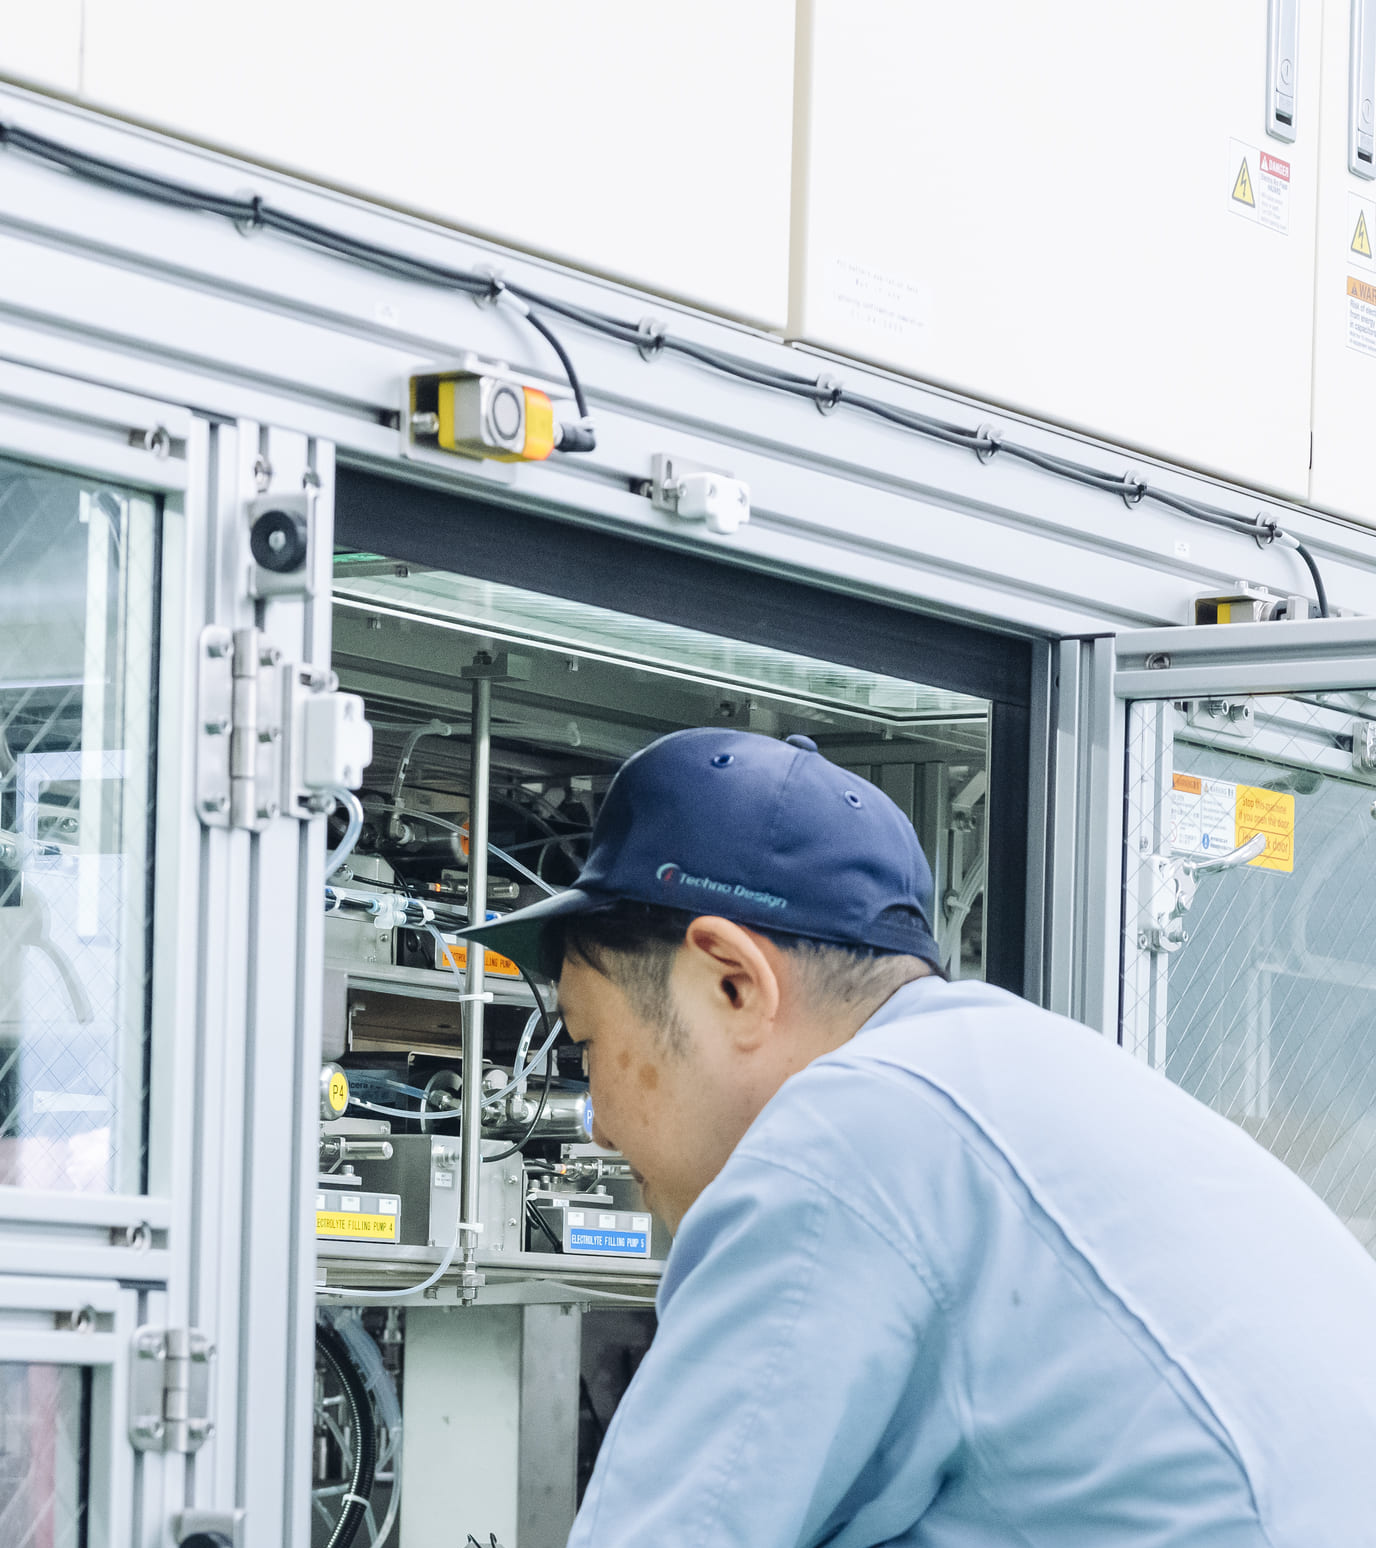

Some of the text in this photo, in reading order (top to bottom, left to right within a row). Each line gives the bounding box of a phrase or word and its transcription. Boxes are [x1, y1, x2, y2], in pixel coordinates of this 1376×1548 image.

[679, 873, 788, 909] Techno Design
[332, 1084, 344, 1100] P4
[316, 1218, 346, 1230] ECTROLYTE
[348, 1219, 371, 1231] FILLING
[373, 1221, 387, 1232] PUMP
[571, 1234, 603, 1246] ELECTROLYTE
[604, 1235, 626, 1247] FILLING
[626, 1237, 639, 1248] PUMP
